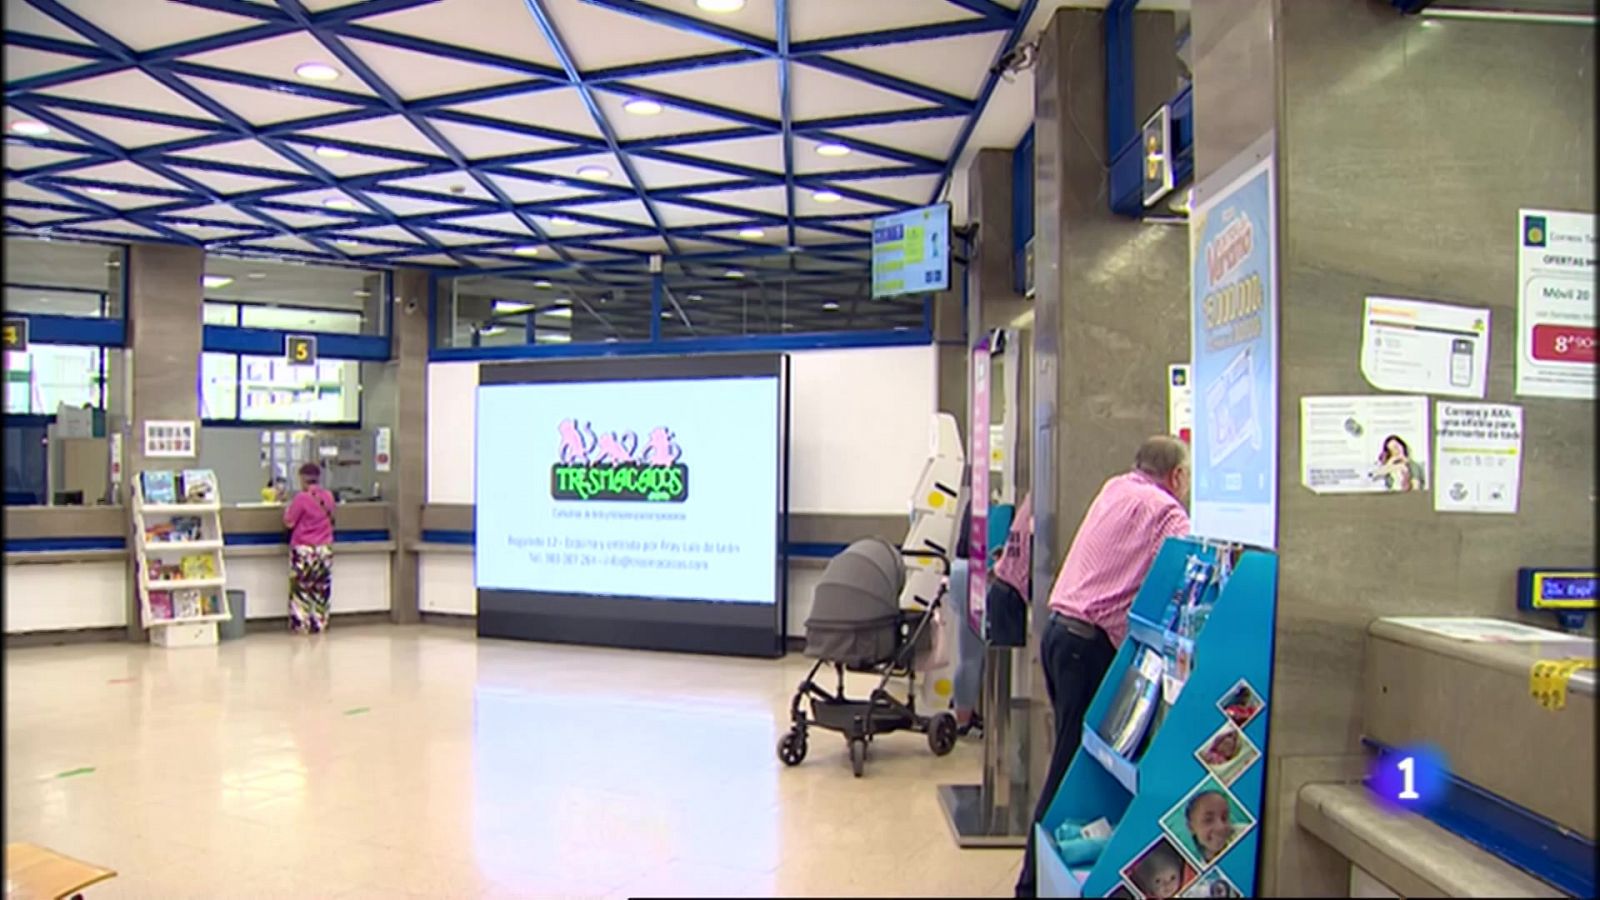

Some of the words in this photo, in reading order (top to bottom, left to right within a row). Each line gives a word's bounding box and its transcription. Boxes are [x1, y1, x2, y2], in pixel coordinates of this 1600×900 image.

[1542, 254, 1584, 268] OFERTAS
[1542, 287, 1574, 300] Móvil
[1576, 289, 1590, 301] 20
[295, 342, 308, 361] 5
